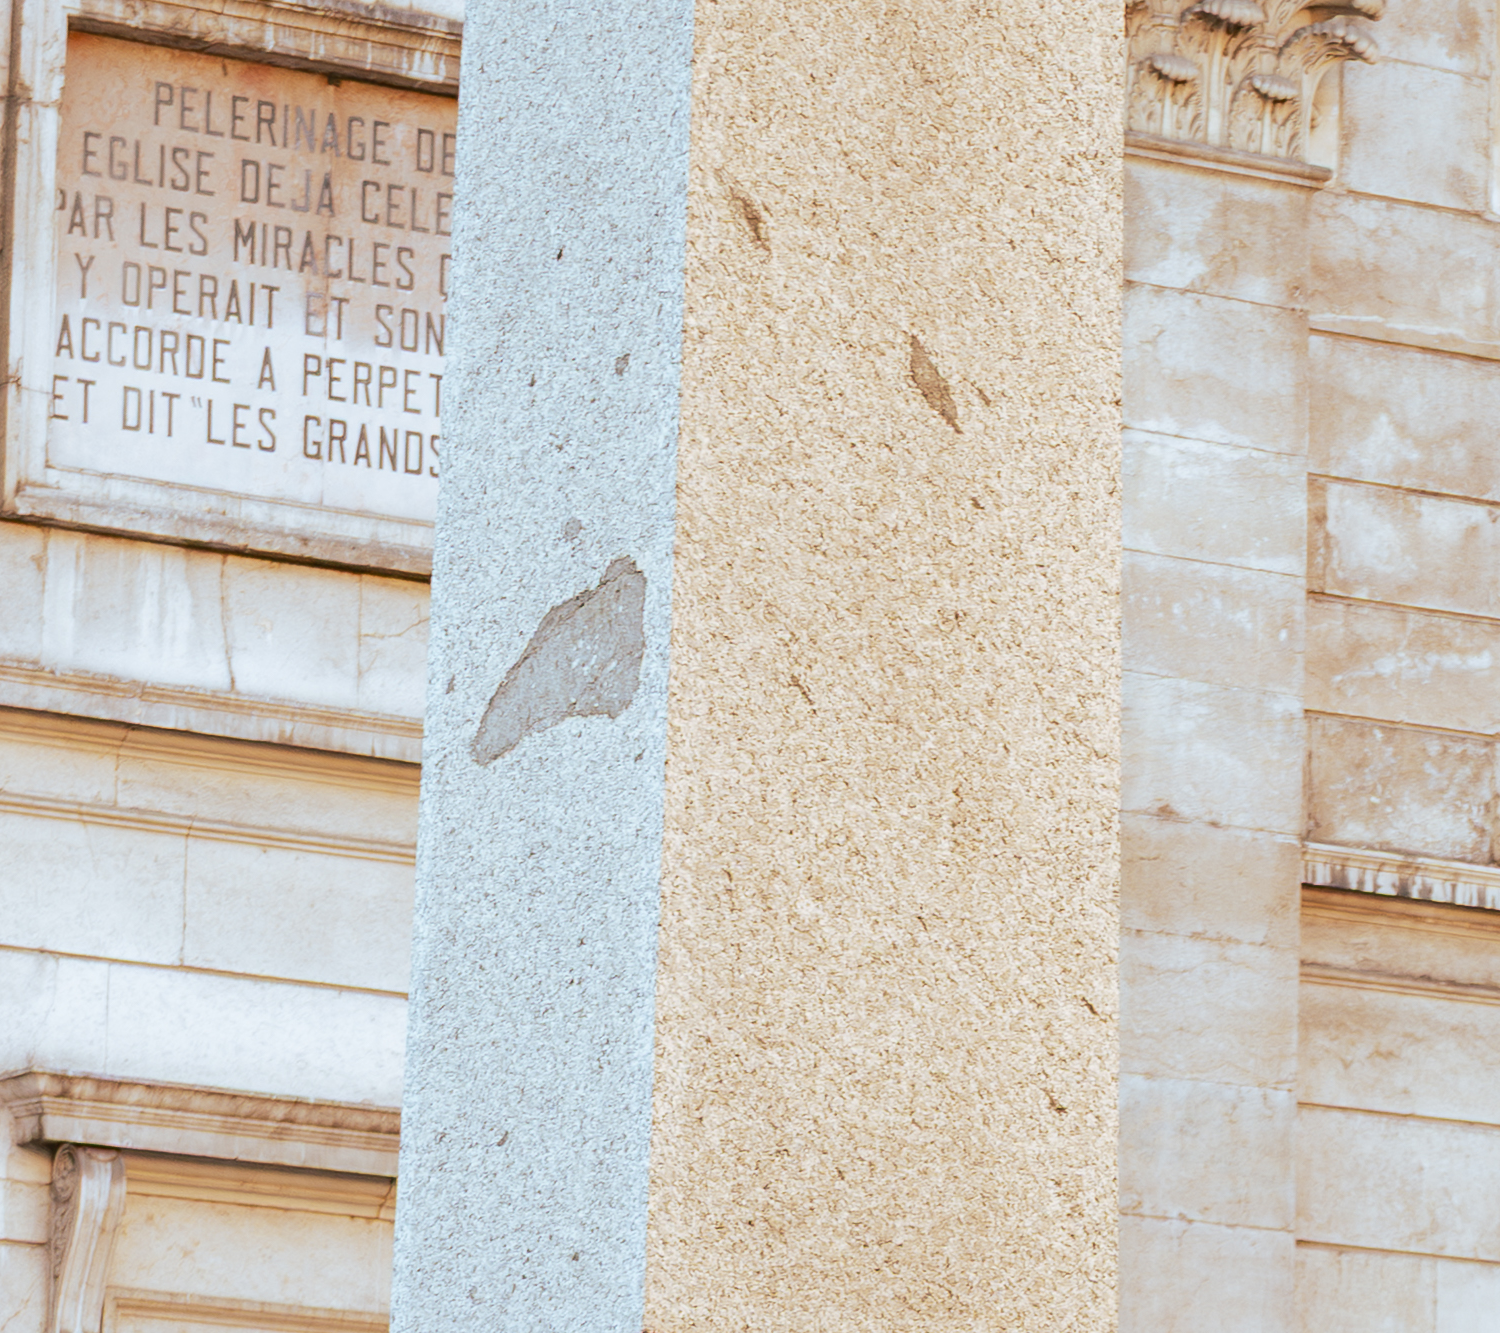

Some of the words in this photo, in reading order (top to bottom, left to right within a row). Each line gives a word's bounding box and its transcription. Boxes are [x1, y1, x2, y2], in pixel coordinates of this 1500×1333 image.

[154, 81, 391, 166] PELERINAGE
[82, 131, 216, 197] EGLISE
[240, 158, 335, 218] DEJA
[140, 201, 208, 257] LES
[233, 219, 414, 292] MIRACLES
[74, 252, 95, 299] Y
[122, 260, 280, 330] OPERAIT
[303, 291, 350, 341] ET
[373, 303, 445, 357] SON
[55, 313, 232, 384] ACCORDE
[257, 346, 277, 391] A
[50, 374, 96, 424] ET
[122, 385, 182, 437] DIT
